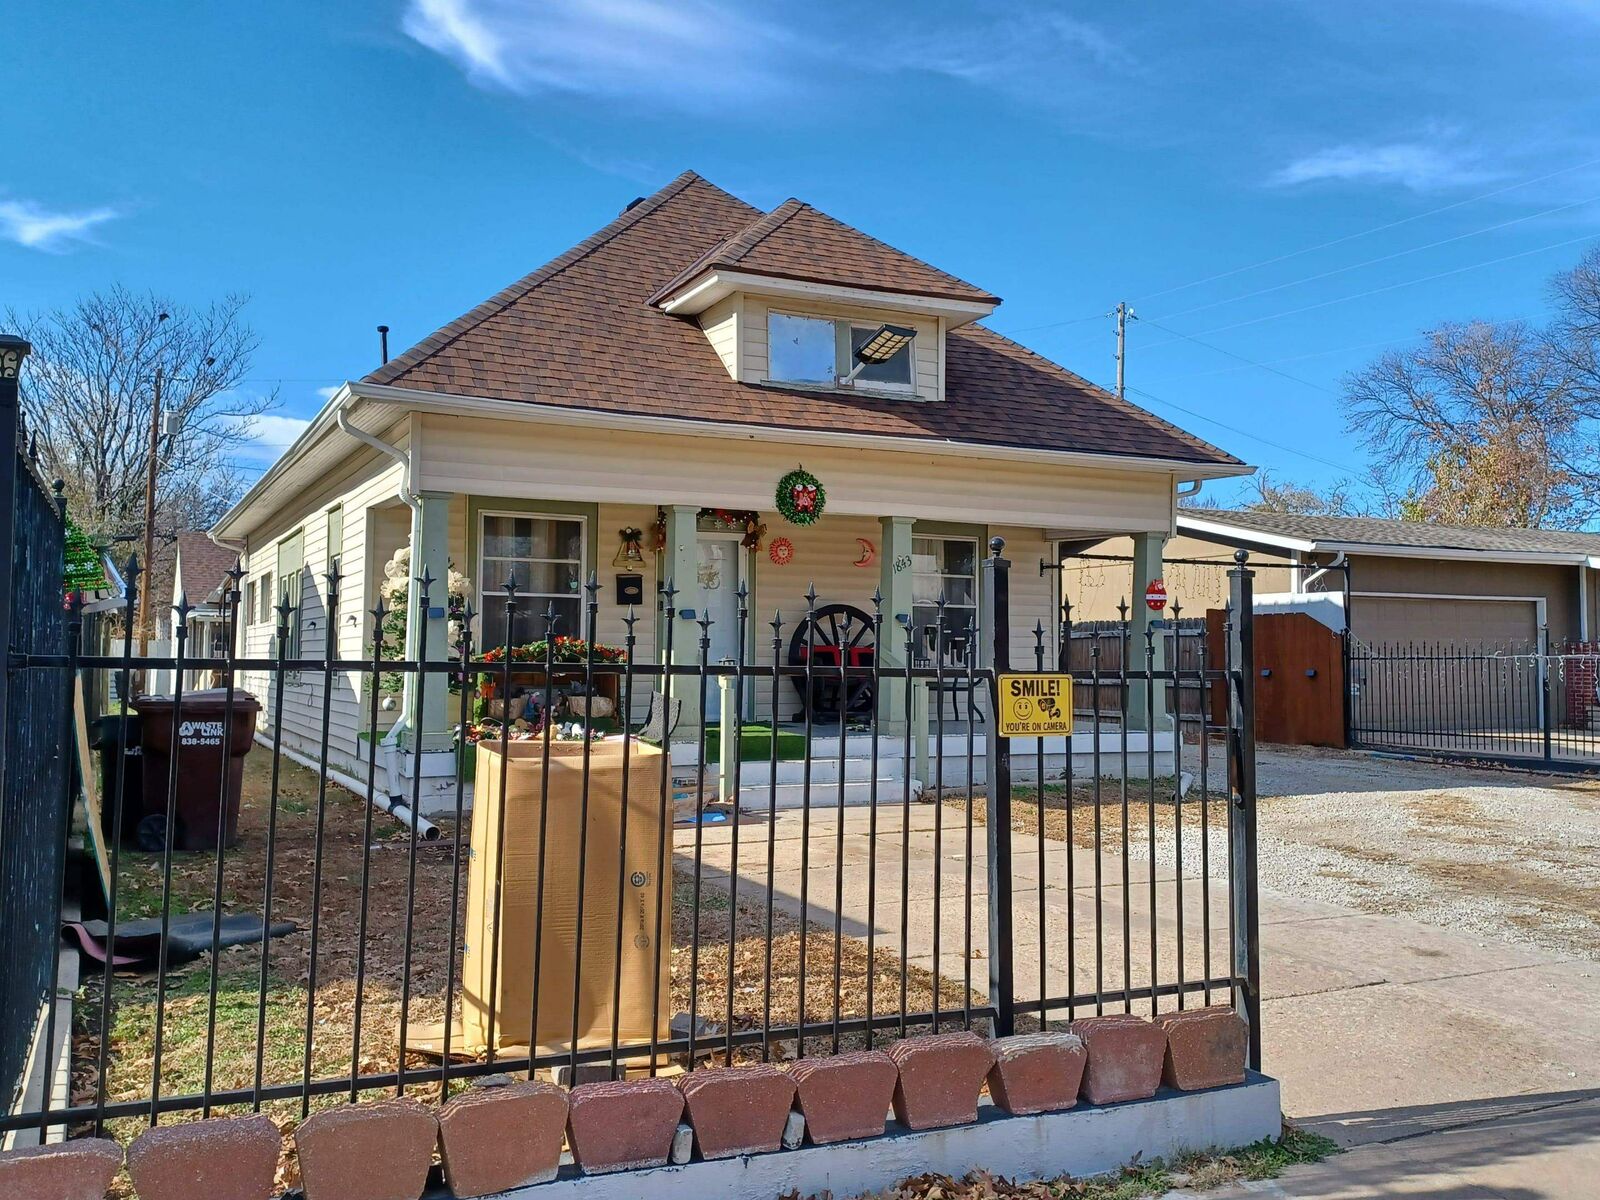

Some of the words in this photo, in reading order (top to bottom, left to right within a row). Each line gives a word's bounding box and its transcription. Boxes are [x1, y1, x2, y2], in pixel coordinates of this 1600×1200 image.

[893, 555, 912, 574] 1843
[1010, 680, 1060, 697] SMILE!
[191, 721, 223, 730] WASTE
[1006, 721, 1030, 732] YOU'RE
[1032, 722, 1041, 731] ON
[1043, 721, 1067, 731] CAMERA
[201, 728, 224, 736] LINK
